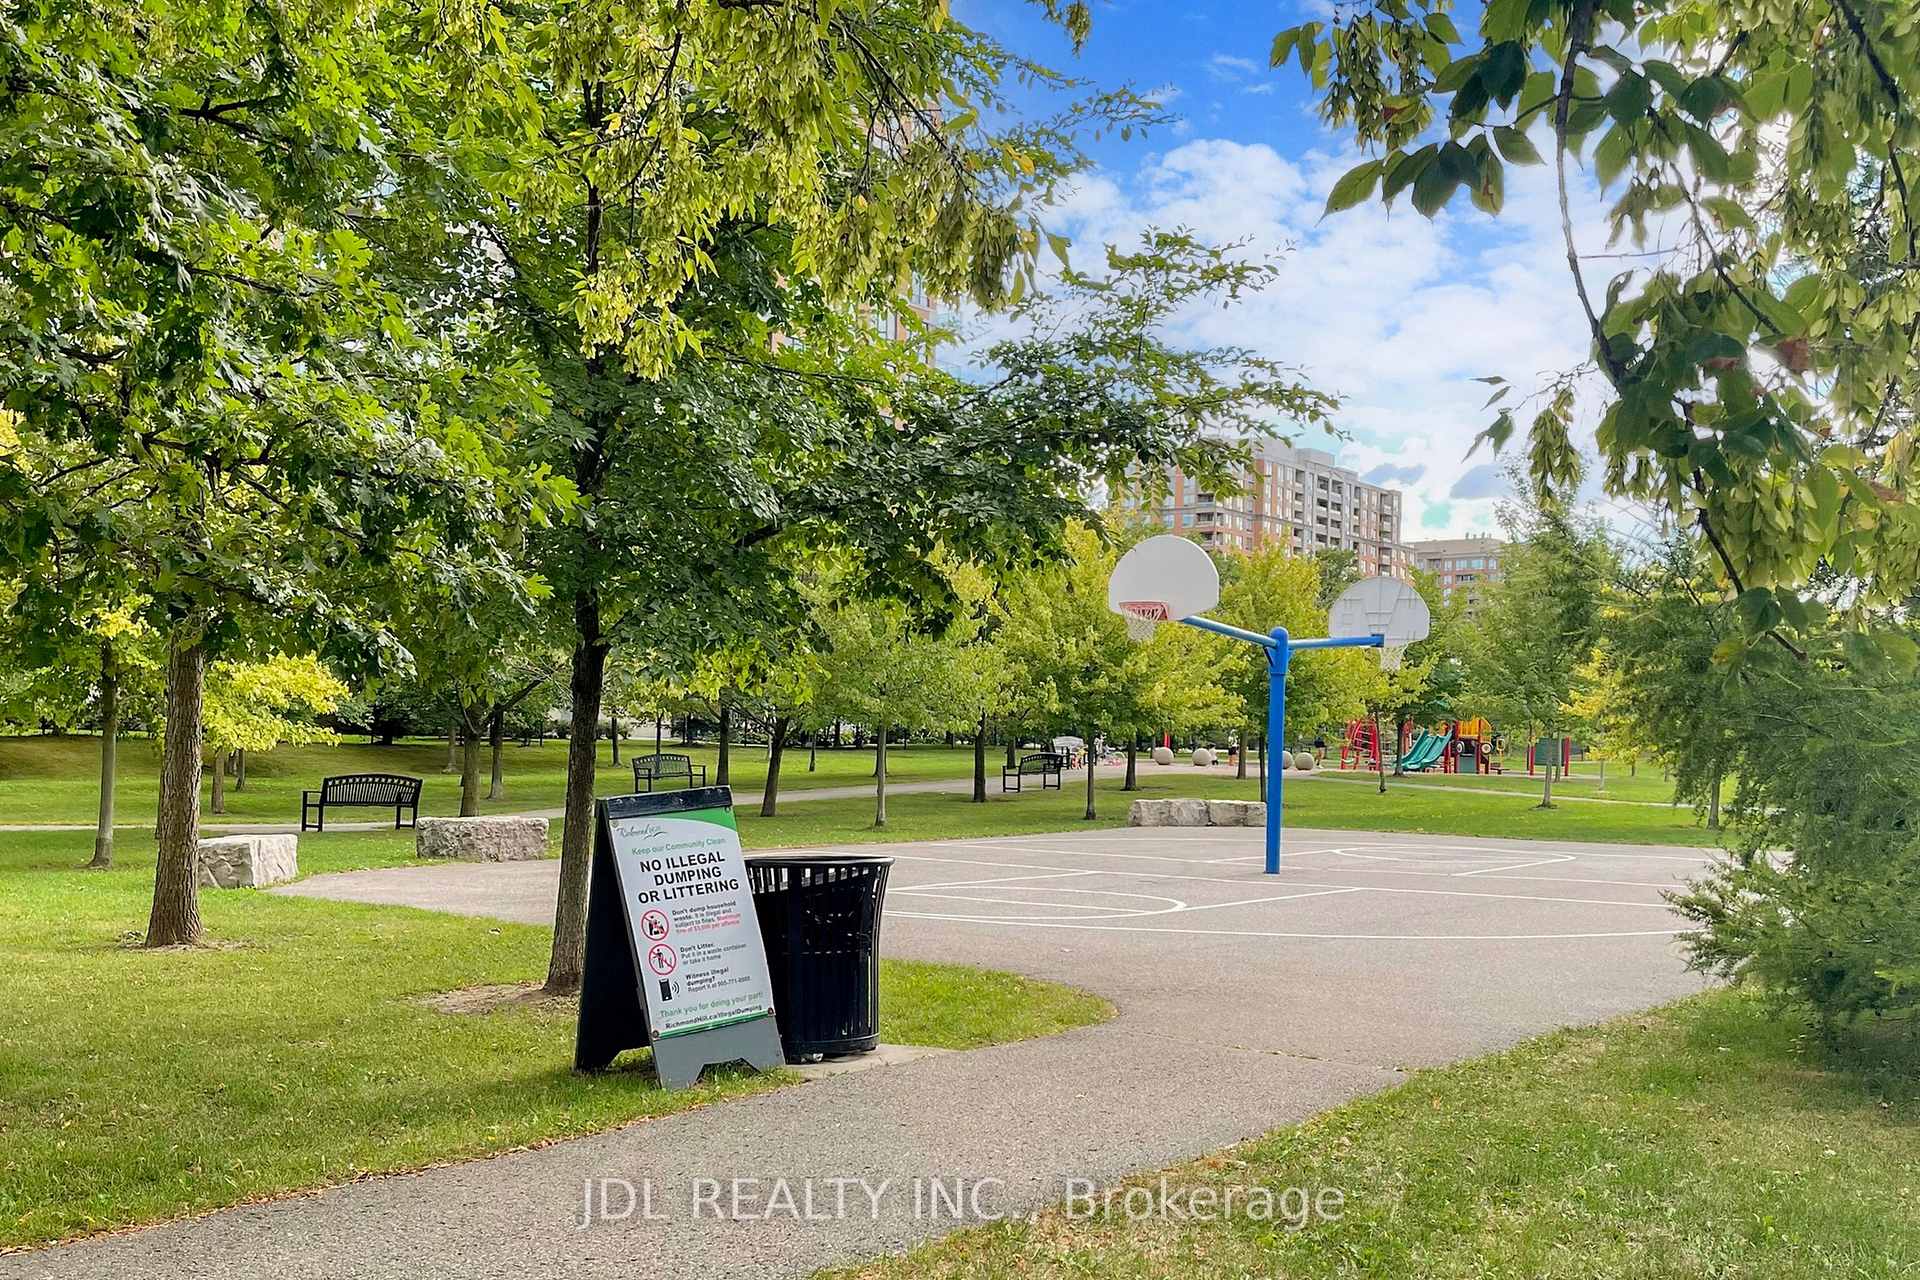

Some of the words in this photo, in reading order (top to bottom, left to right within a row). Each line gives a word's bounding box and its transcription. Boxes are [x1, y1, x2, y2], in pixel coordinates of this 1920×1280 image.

[632, 847, 651, 855] Keep
[652, 845, 665, 853] our
[666, 840, 704, 851] Community
[706, 838, 725, 846] Clean
[640, 860, 661, 872] NO
[666, 851, 725, 869] ILLEGAL
[654, 866, 722, 886] DUMPING
[638, 891, 660, 903] OR
[664, 879, 739, 900] LITTERING
[689, 905, 706, 913] dump
[707, 901, 736, 910] household
[707, 947, 723, 955] waste
[685, 971, 710, 980] Witness
[687, 976, 715, 986] dumping?
[688, 984, 706, 992] Report
[661, 1007, 684, 1017] Thank
[685, 1005, 698, 1015] you
[699, 1000, 709, 1010] for
[710, 997, 731, 1008] doing
[731, 994, 747, 1005] your
